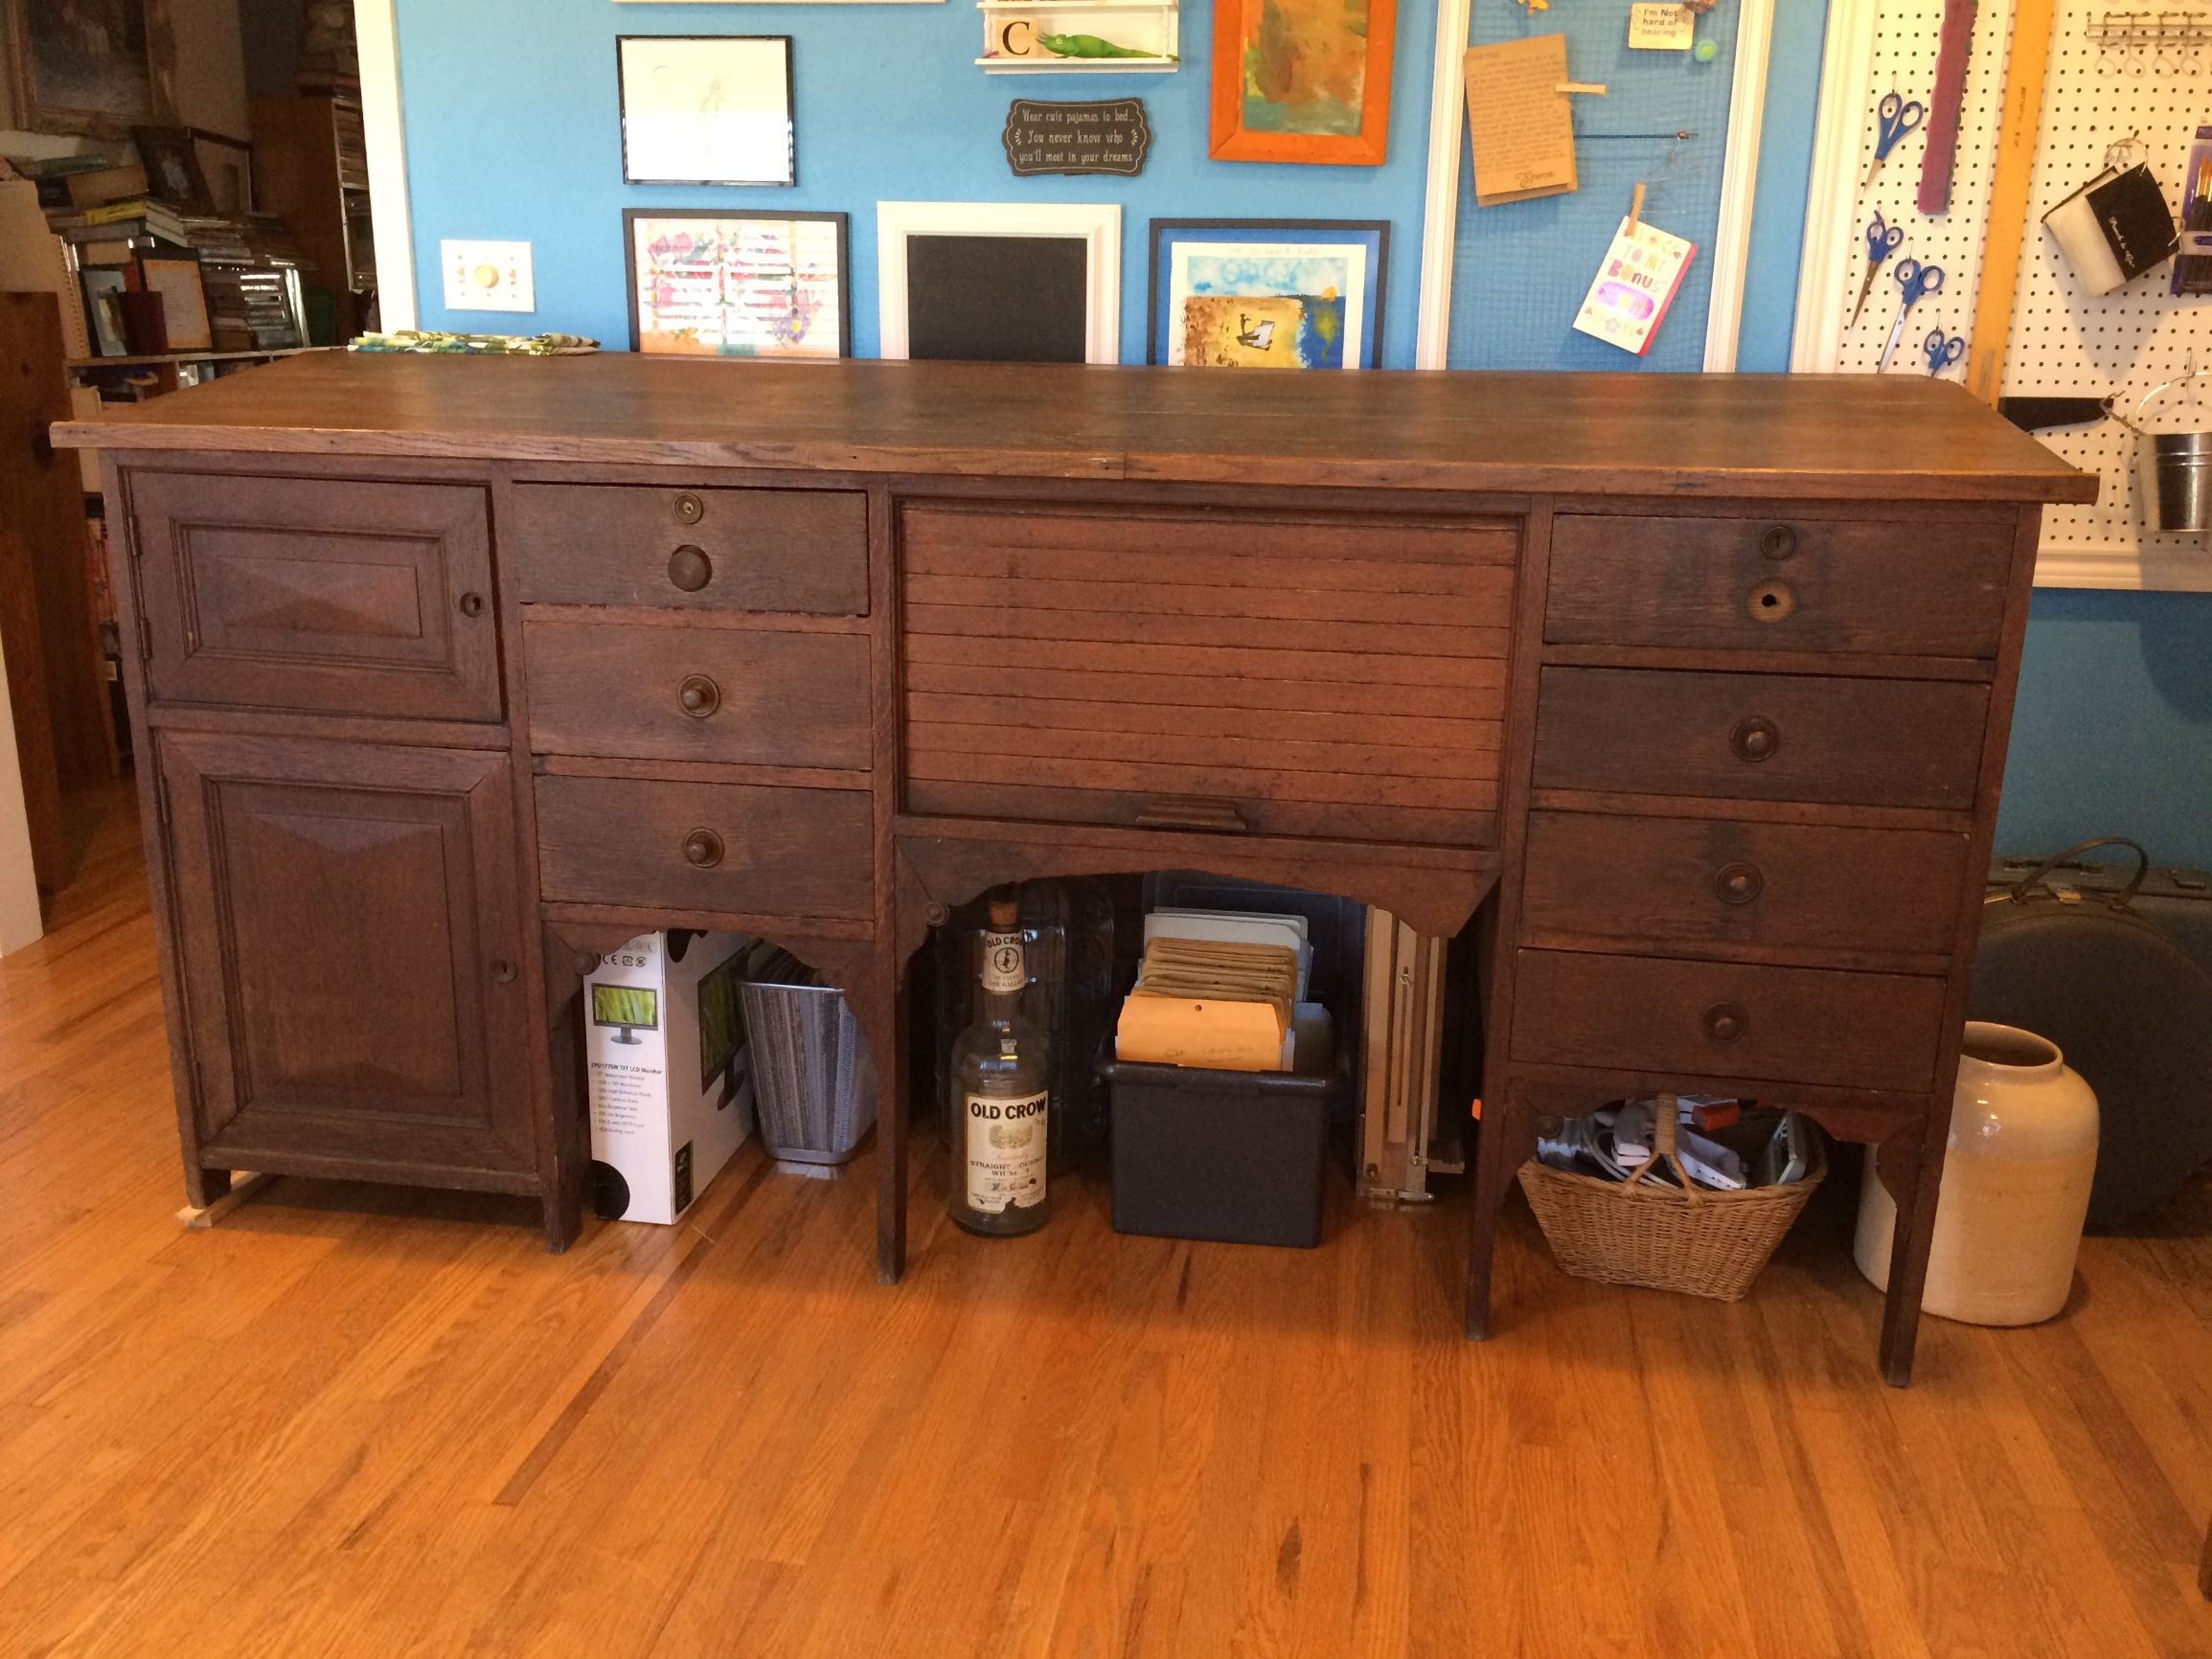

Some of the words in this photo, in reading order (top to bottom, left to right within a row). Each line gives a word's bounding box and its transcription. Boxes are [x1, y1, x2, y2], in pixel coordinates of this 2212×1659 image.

[1668, 18, 1677, 27] of
[1001, 21, 1031, 56] C
[1022, 108, 1043, 123] Wear
[1045, 111, 1062, 123] cute
[1066, 111, 1100, 125] pajamas
[1103, 110, 1110, 122] to
[1027, 129, 1044, 145] You
[1048, 133, 1073, 144] never
[1077, 129, 1101, 144] know
[1106, 129, 1124, 145] who
[1018, 148, 1041, 164] you'll
[1045, 150, 1063, 162] meet
[1068, 151, 1077, 162] in
[1081, 152, 1100, 165] your
[1103, 148, 1133, 162] dreams
[987, 937, 1002, 948] OLD
[970, 1102, 1001, 1120] OLD
[1005, 1097, 1046, 1120] CROW
